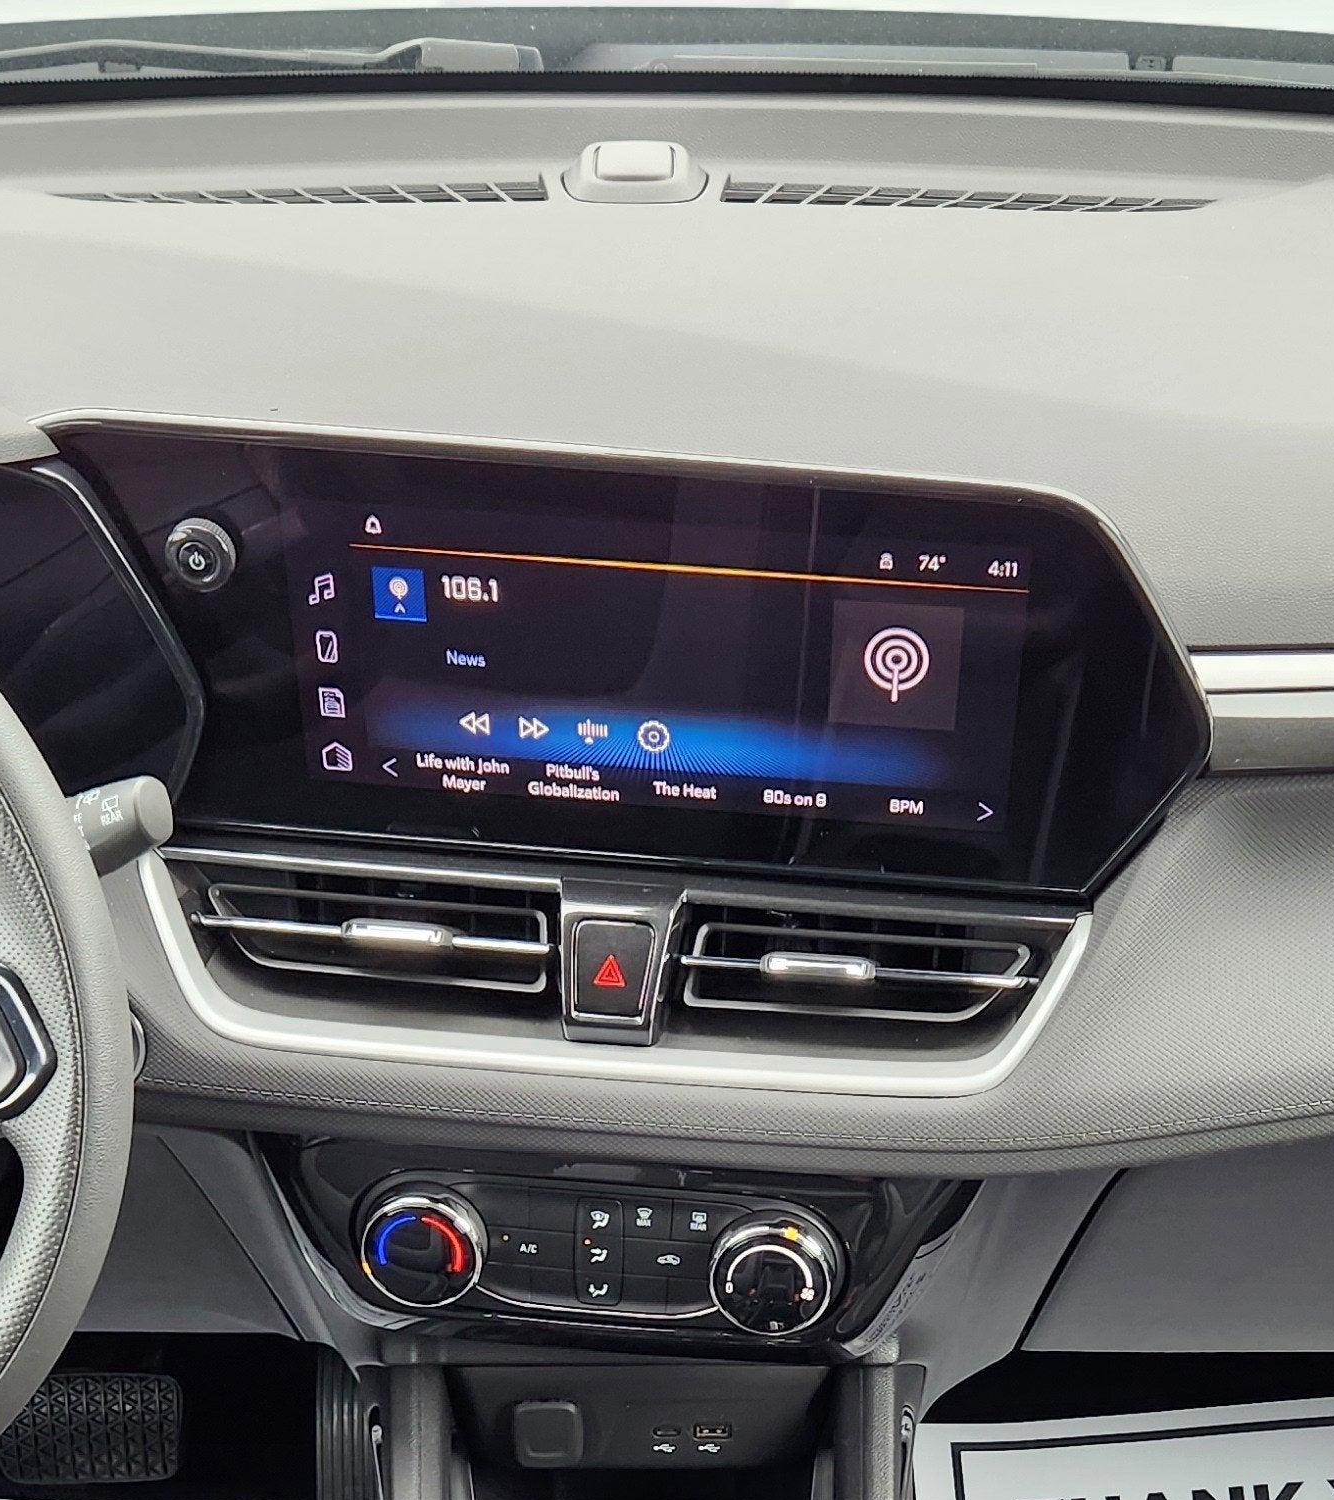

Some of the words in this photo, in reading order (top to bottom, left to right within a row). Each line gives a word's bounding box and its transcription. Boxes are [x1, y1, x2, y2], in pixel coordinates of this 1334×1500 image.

[988, 560, 1018, 577] 4:11
[441, 575, 498, 602] 106.1
[446, 649, 486, 667] News
[416, 753, 443, 769] Life
[445, 757, 475, 772] with
[477, 758, 510, 775] John
[546, 763, 600, 781] Pitbull's
[442, 774, 486, 792] Mayer
[528, 781, 620, 801] Globalization
[653, 781, 680, 796] The
[683, 784, 716, 799] Heat
[763, 789, 791, 805] 80s
[794, 795, 813, 806] on
[816, 793, 827, 807] 8
[889, 799, 924, 815] BPM
[100, 810, 124, 826] REAR
[519, 1243, 538, 1254] A/C
